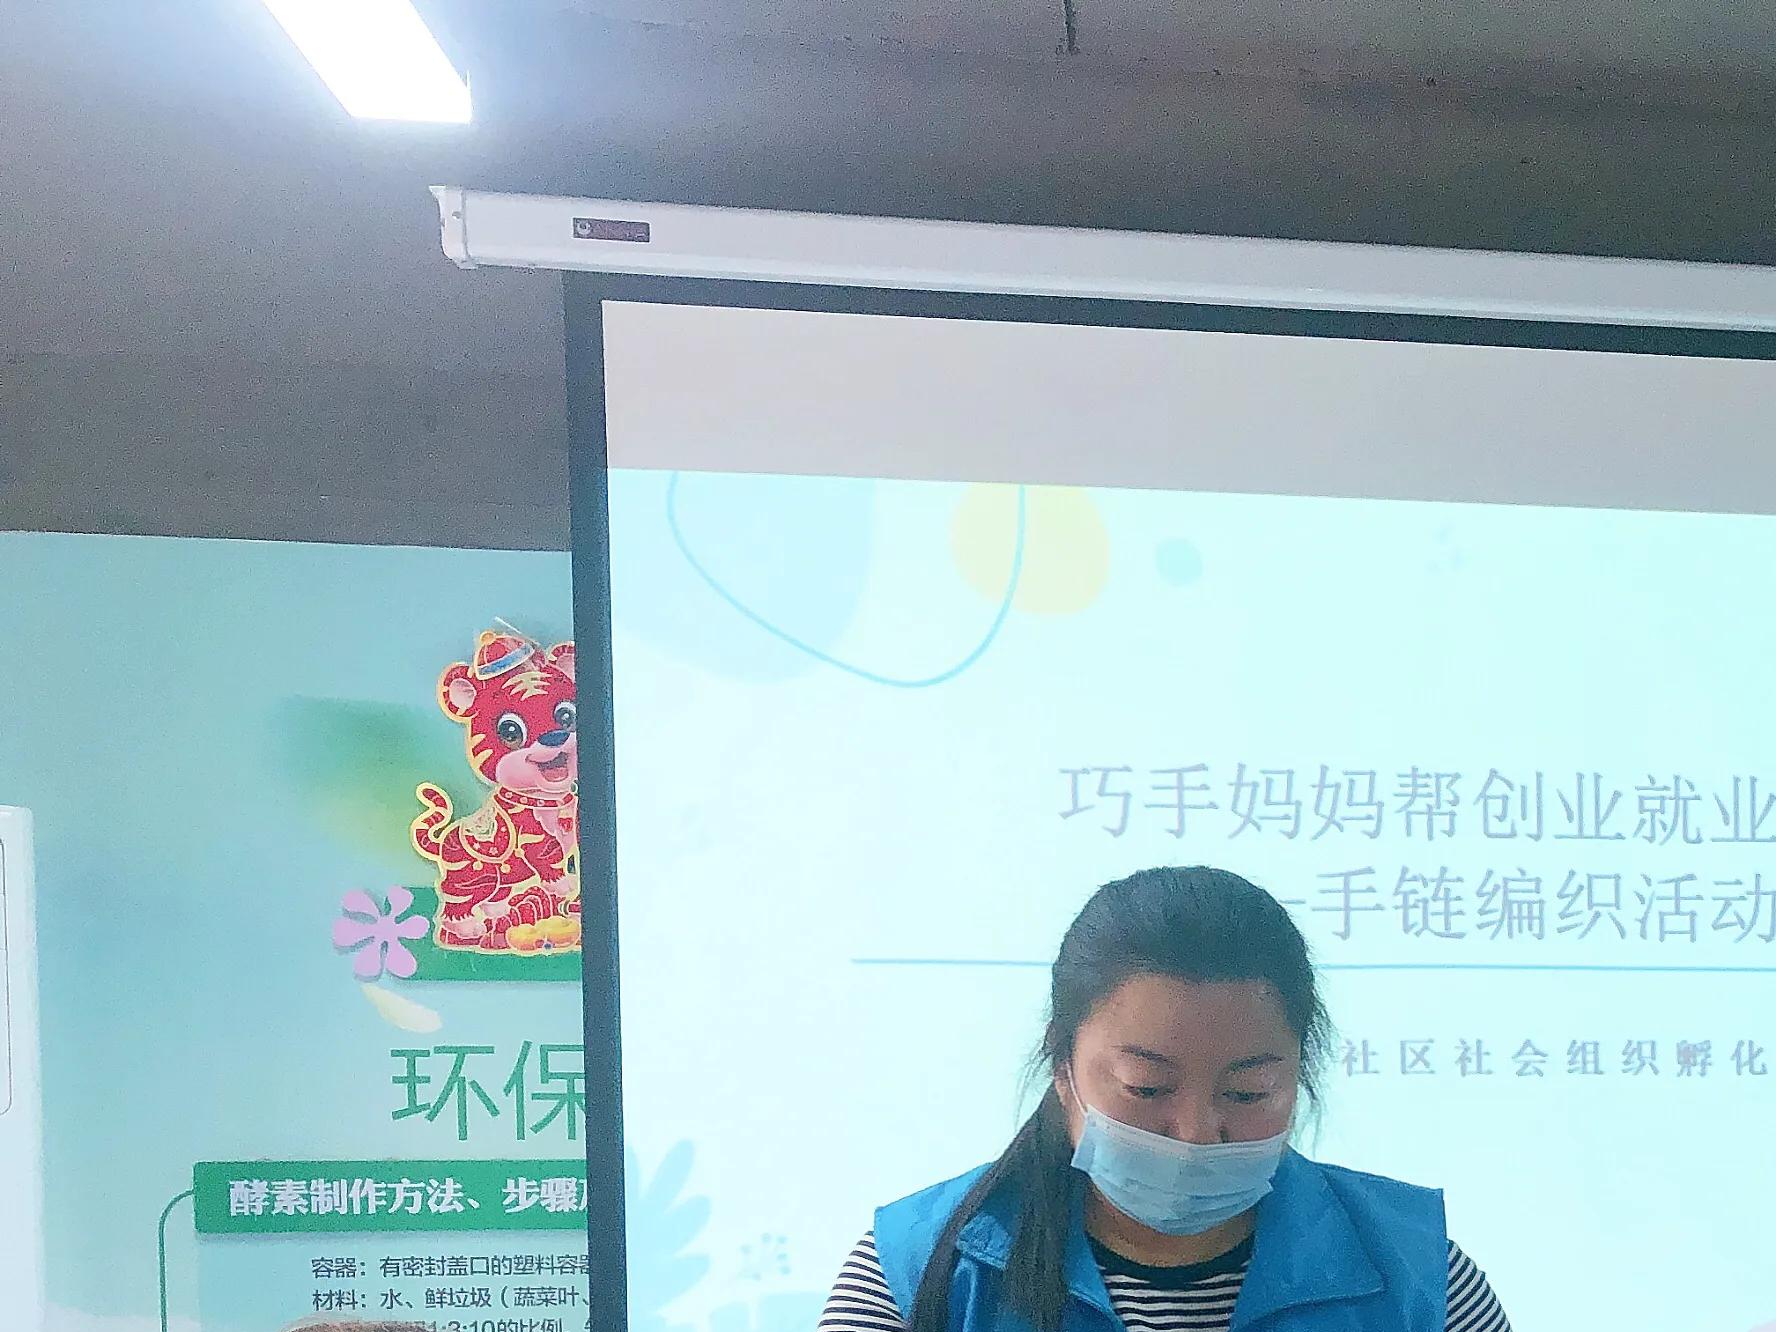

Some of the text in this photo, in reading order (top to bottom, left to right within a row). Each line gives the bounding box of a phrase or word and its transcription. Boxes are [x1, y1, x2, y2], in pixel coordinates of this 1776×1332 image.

[391, 1040, 586, 1142] 环保
[229, 1176, 588, 1217] 酵素制作方法、步骤
